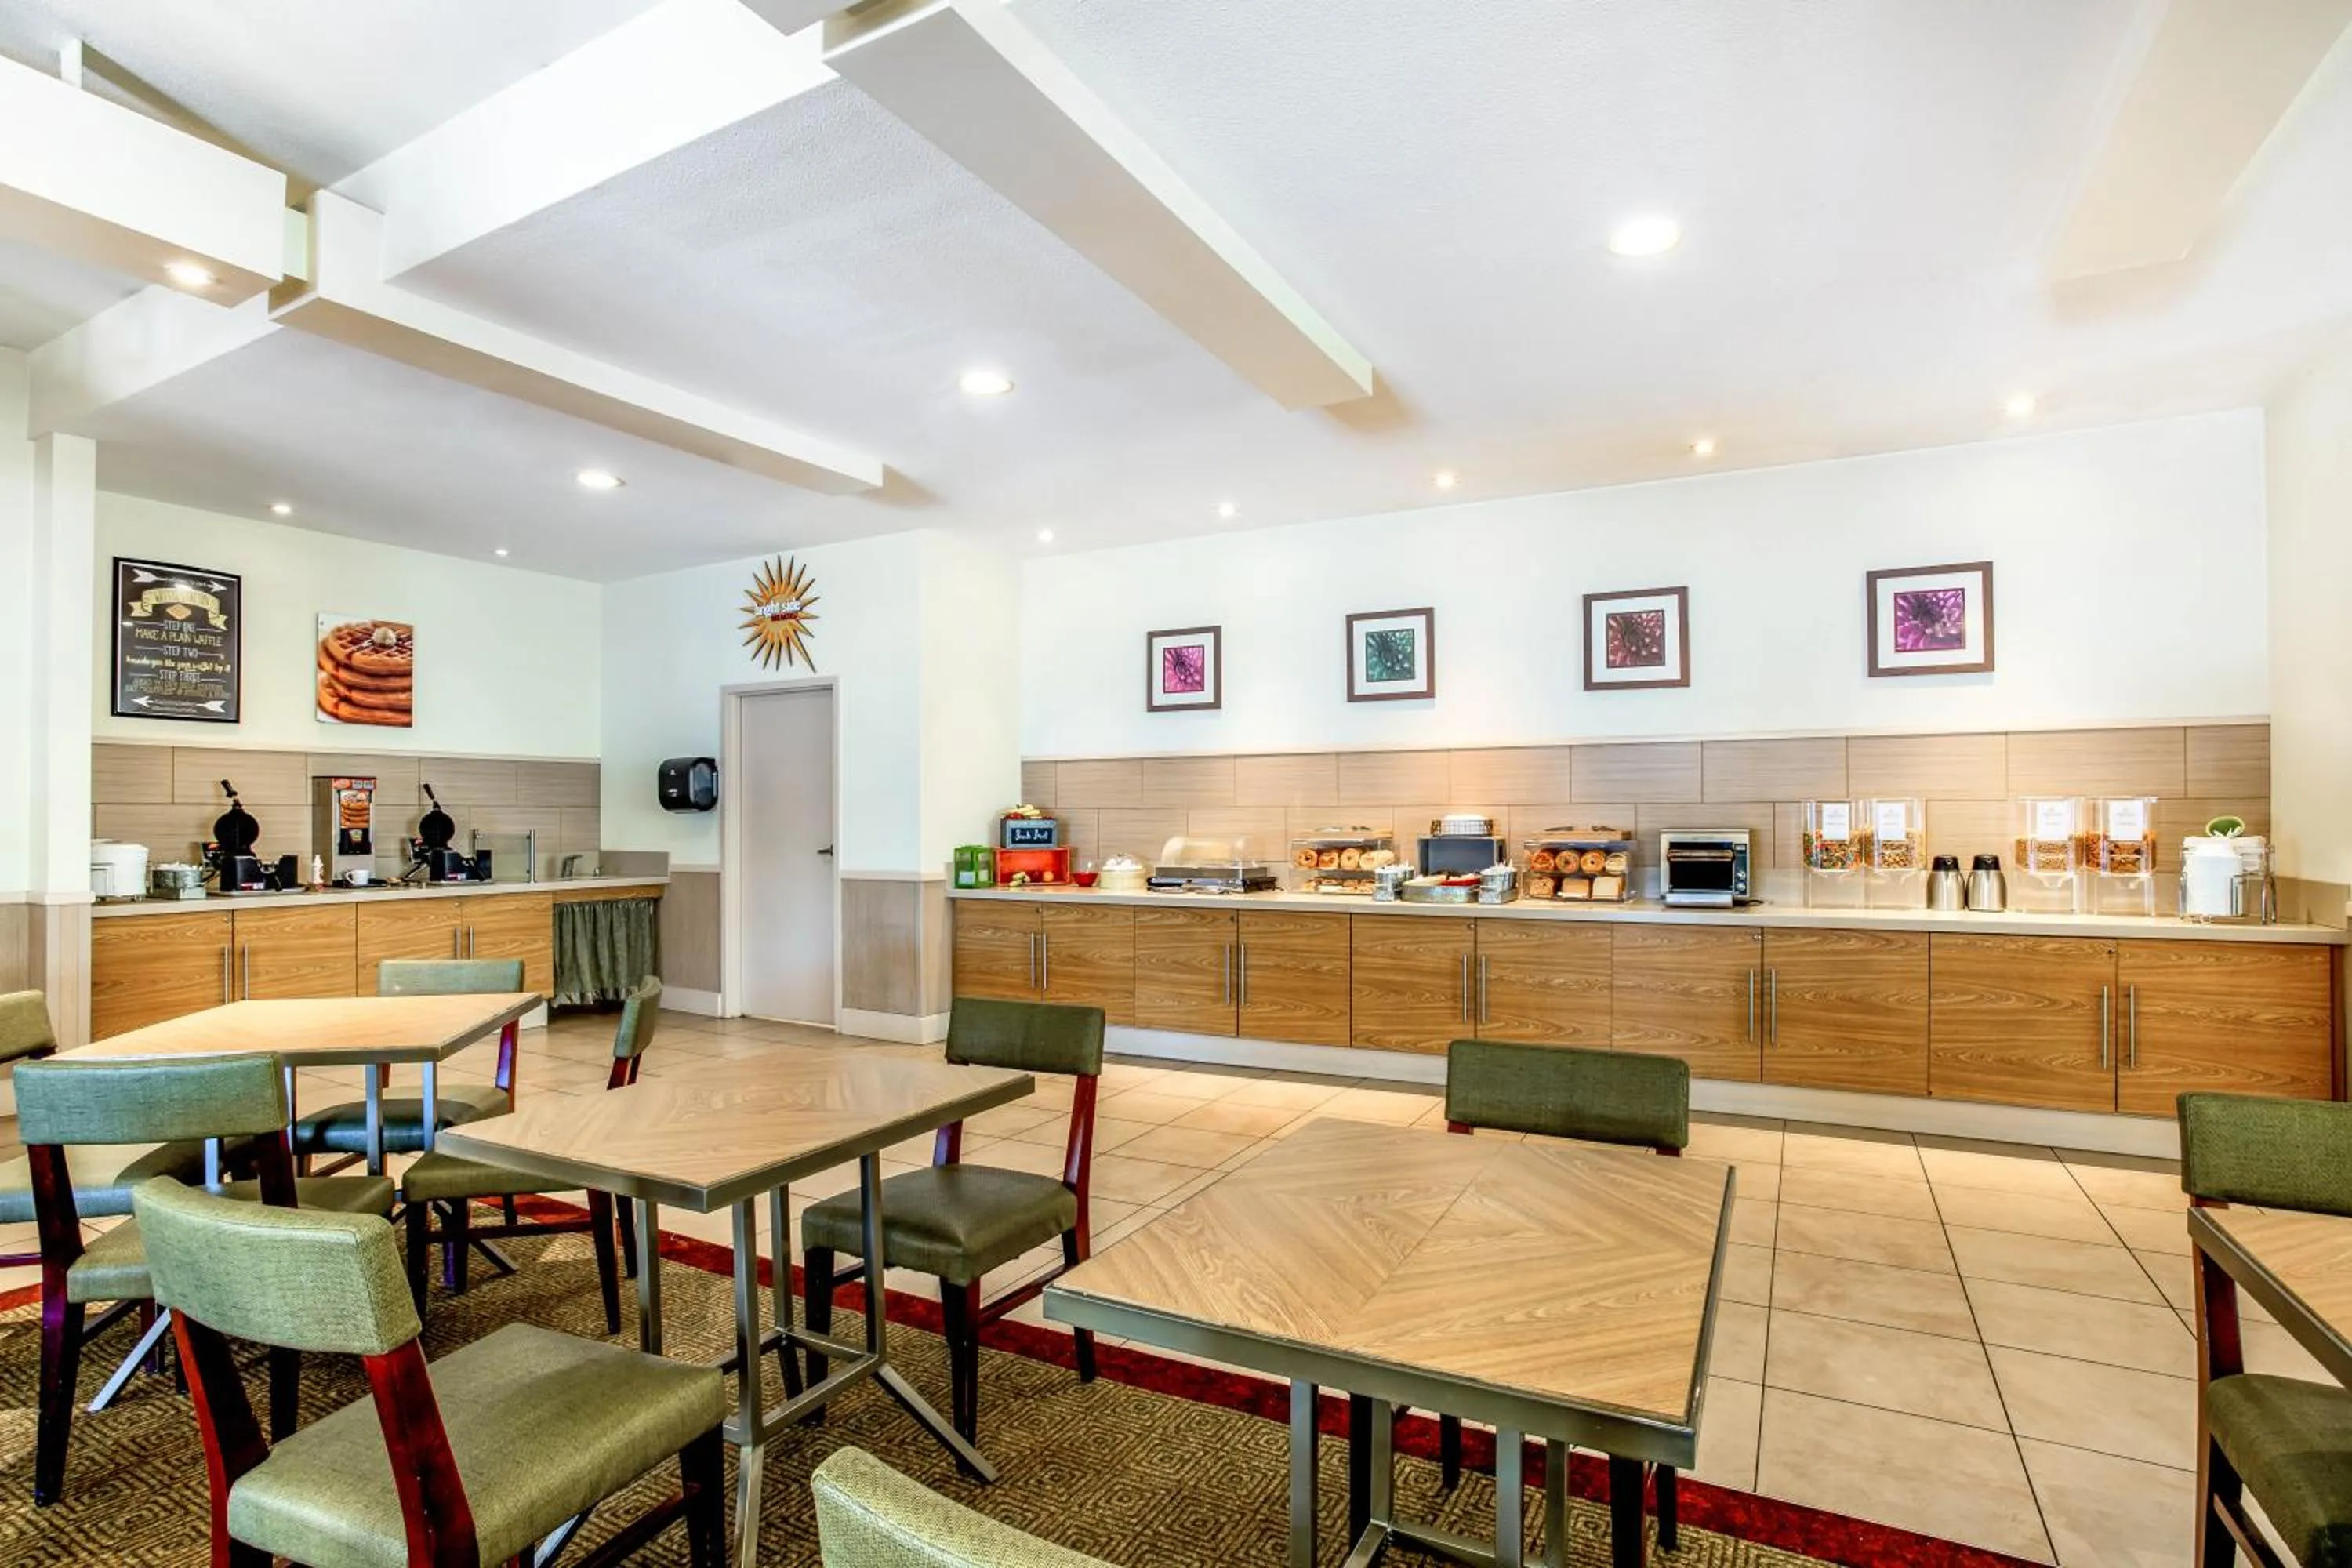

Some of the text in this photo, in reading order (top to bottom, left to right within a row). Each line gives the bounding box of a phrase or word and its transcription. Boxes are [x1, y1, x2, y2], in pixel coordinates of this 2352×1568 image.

[136, 628, 159, 640] MAKE
[161, 630, 167, 640] A
[163, 645, 198, 658] STEP TWO
